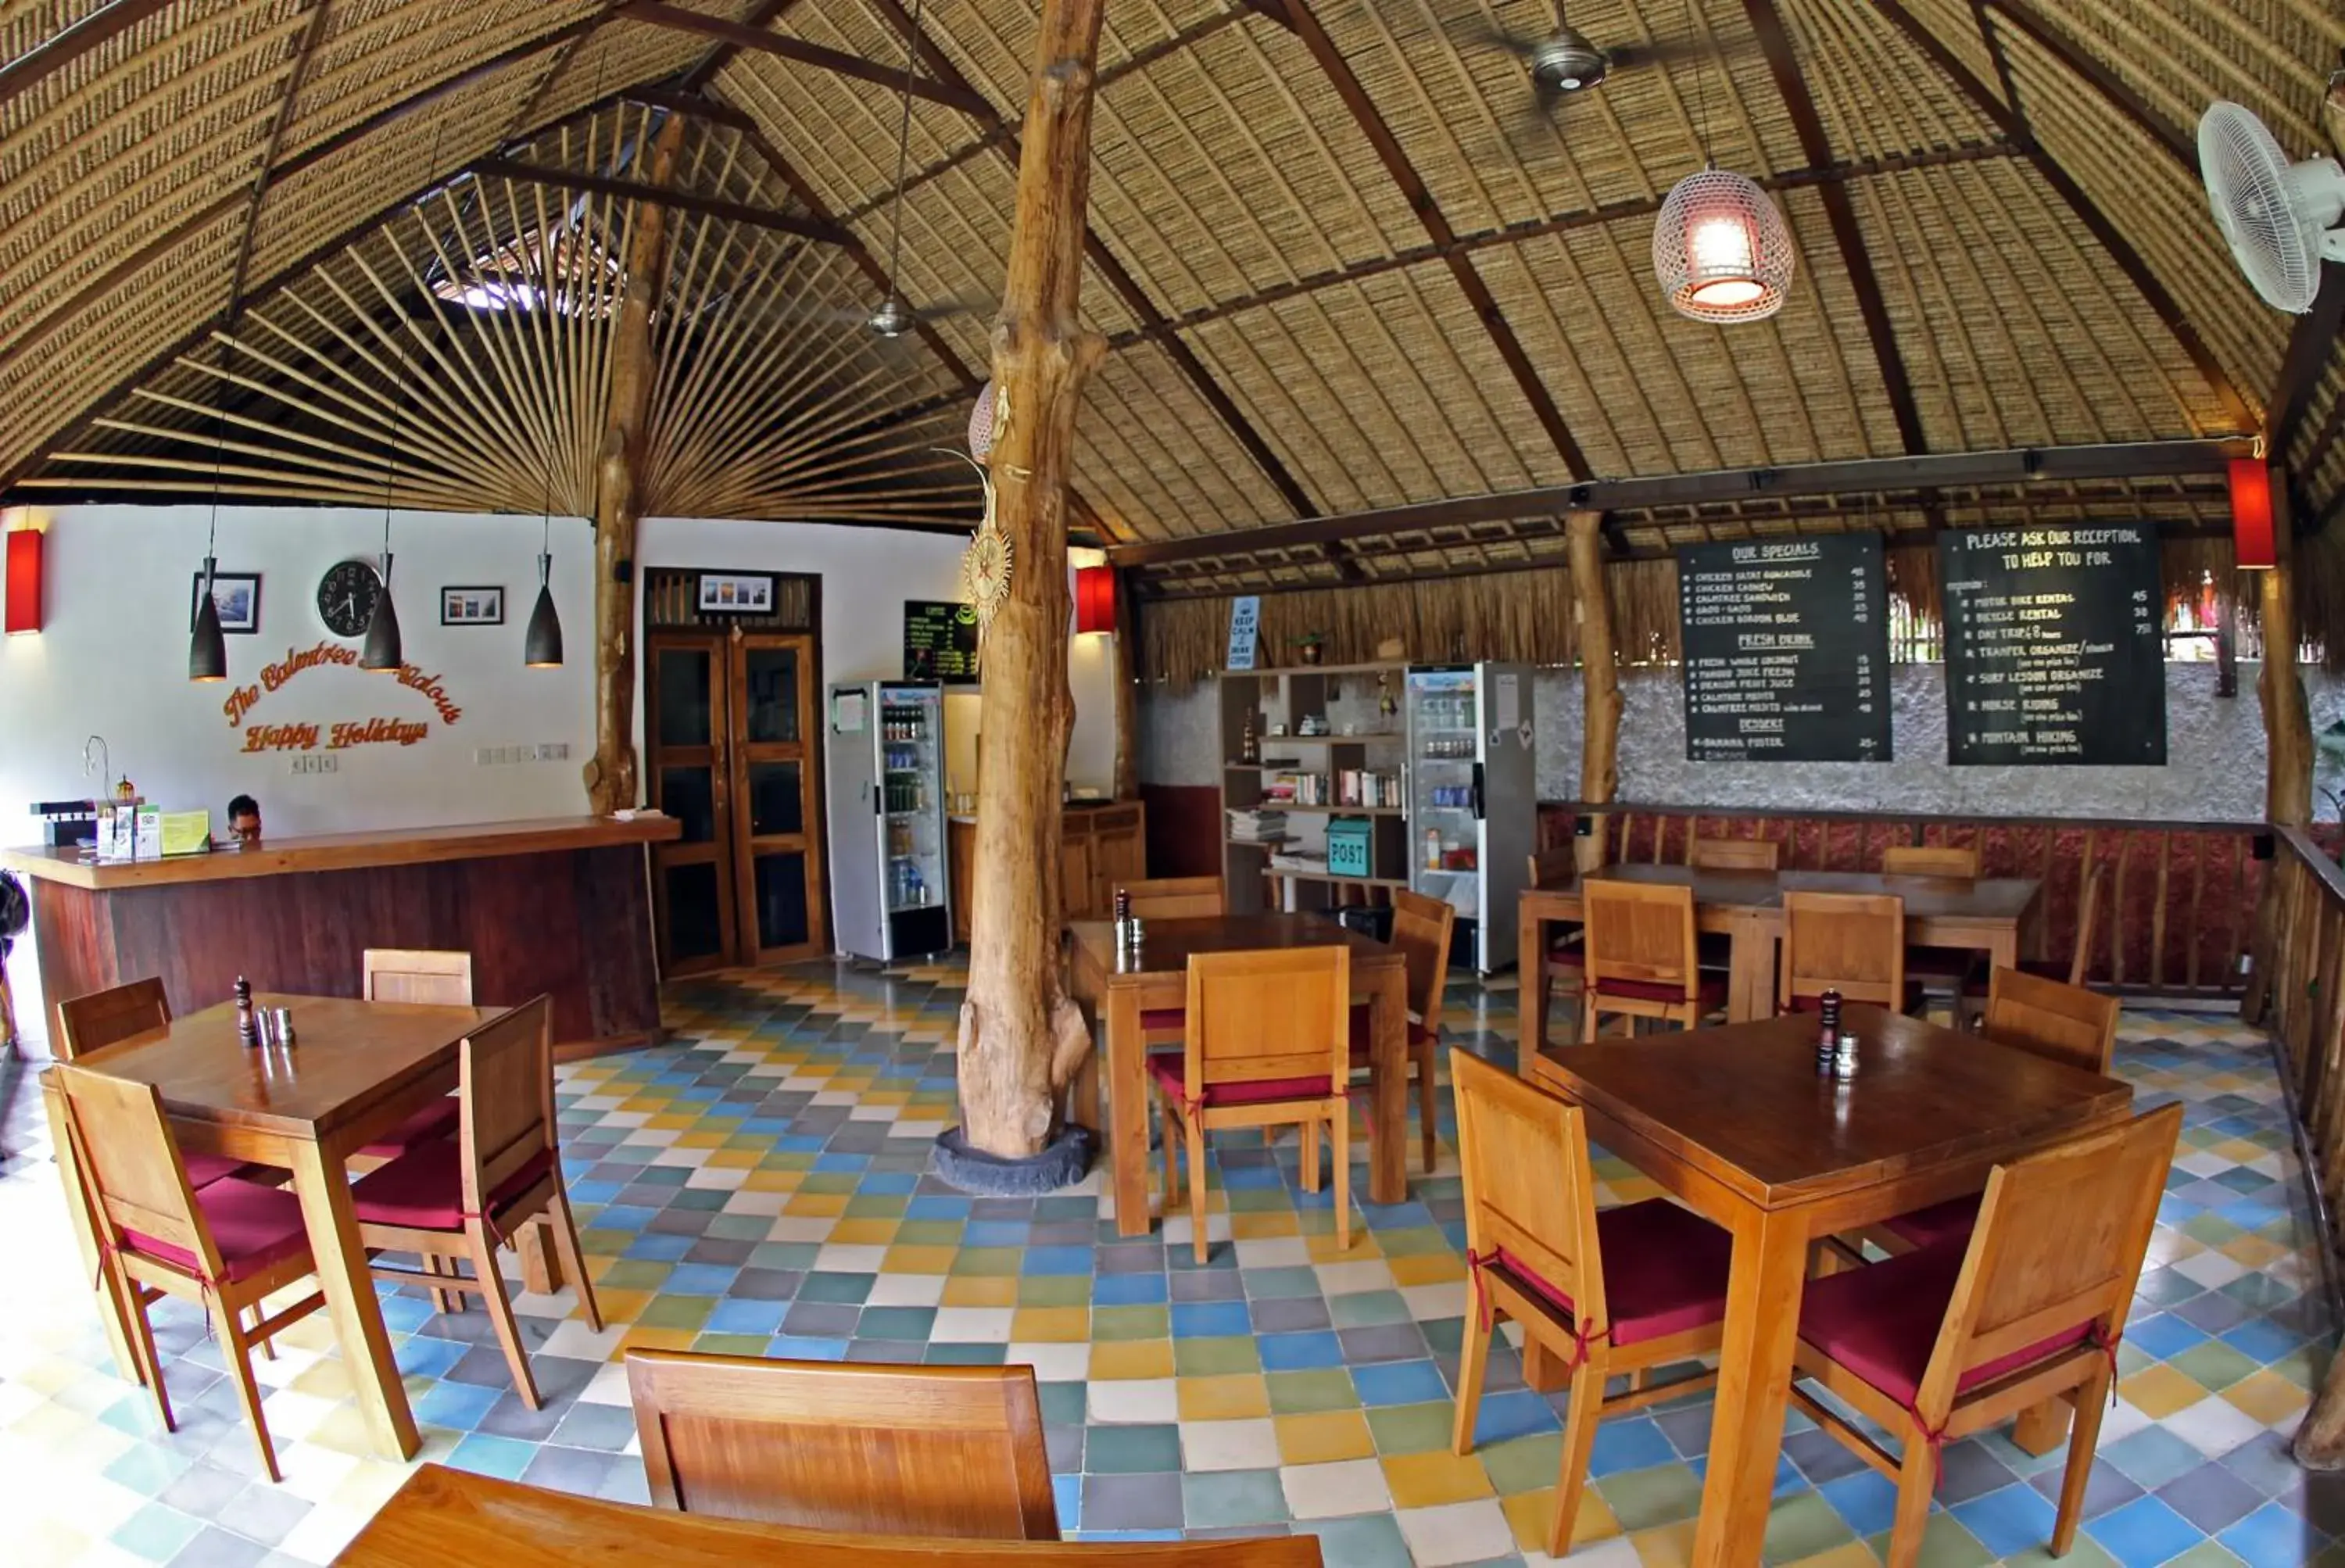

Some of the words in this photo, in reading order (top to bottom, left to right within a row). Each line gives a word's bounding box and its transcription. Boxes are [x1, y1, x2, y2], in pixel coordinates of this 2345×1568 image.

[1966, 532, 2017, 550] PLEASE
[2021, 531, 2046, 546] ASK
[2047, 530, 2071, 545] OUR
[1732, 546, 1756, 559] OUR
[1762, 542, 1819, 558] SPECIALS
[2002, 554, 2018, 570] TO
[2021, 551, 2053, 568] HELP
[2019, 609, 2062, 621] RENTAL
[1738, 634, 1774, 646] FRESH
[1977, 629, 1996, 639] DAY
[1979, 673, 2005, 684] SURF
[224, 684, 260, 727] The
[240, 722, 320, 753] Happy
[326, 718, 428, 749] Holidays
[1332, 843, 1363, 865] POST
